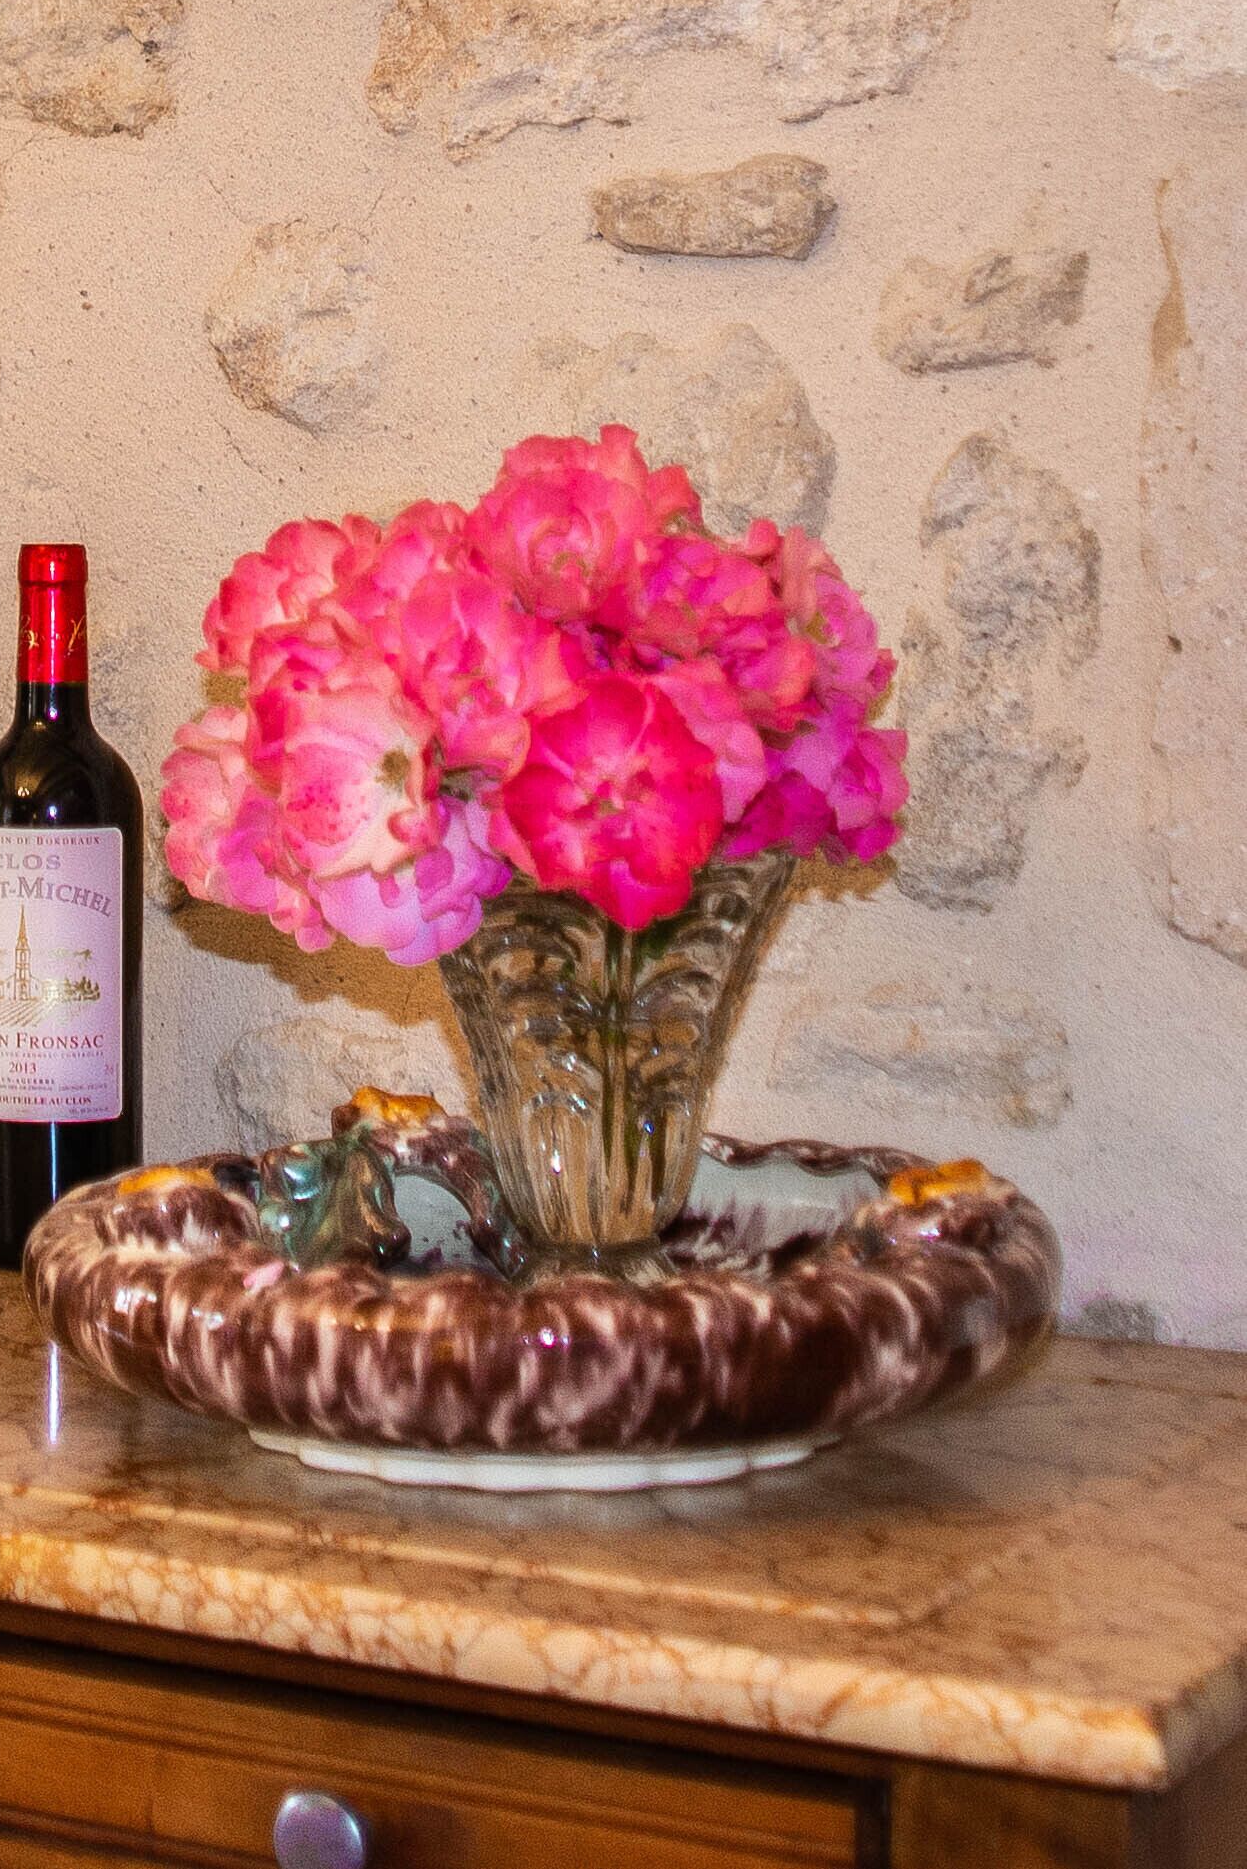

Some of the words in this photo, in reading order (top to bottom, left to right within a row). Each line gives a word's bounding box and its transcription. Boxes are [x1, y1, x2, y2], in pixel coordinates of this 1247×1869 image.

[16, 836, 30, 845] DE
[37, 836, 102, 845] BORDEAUX
[16, 1032, 105, 1050] FRONSAC
[9, 1061, 37, 1074] 2013
[49, 1097, 63, 1106] AU
[65, 1096, 92, 1106] CLOS
